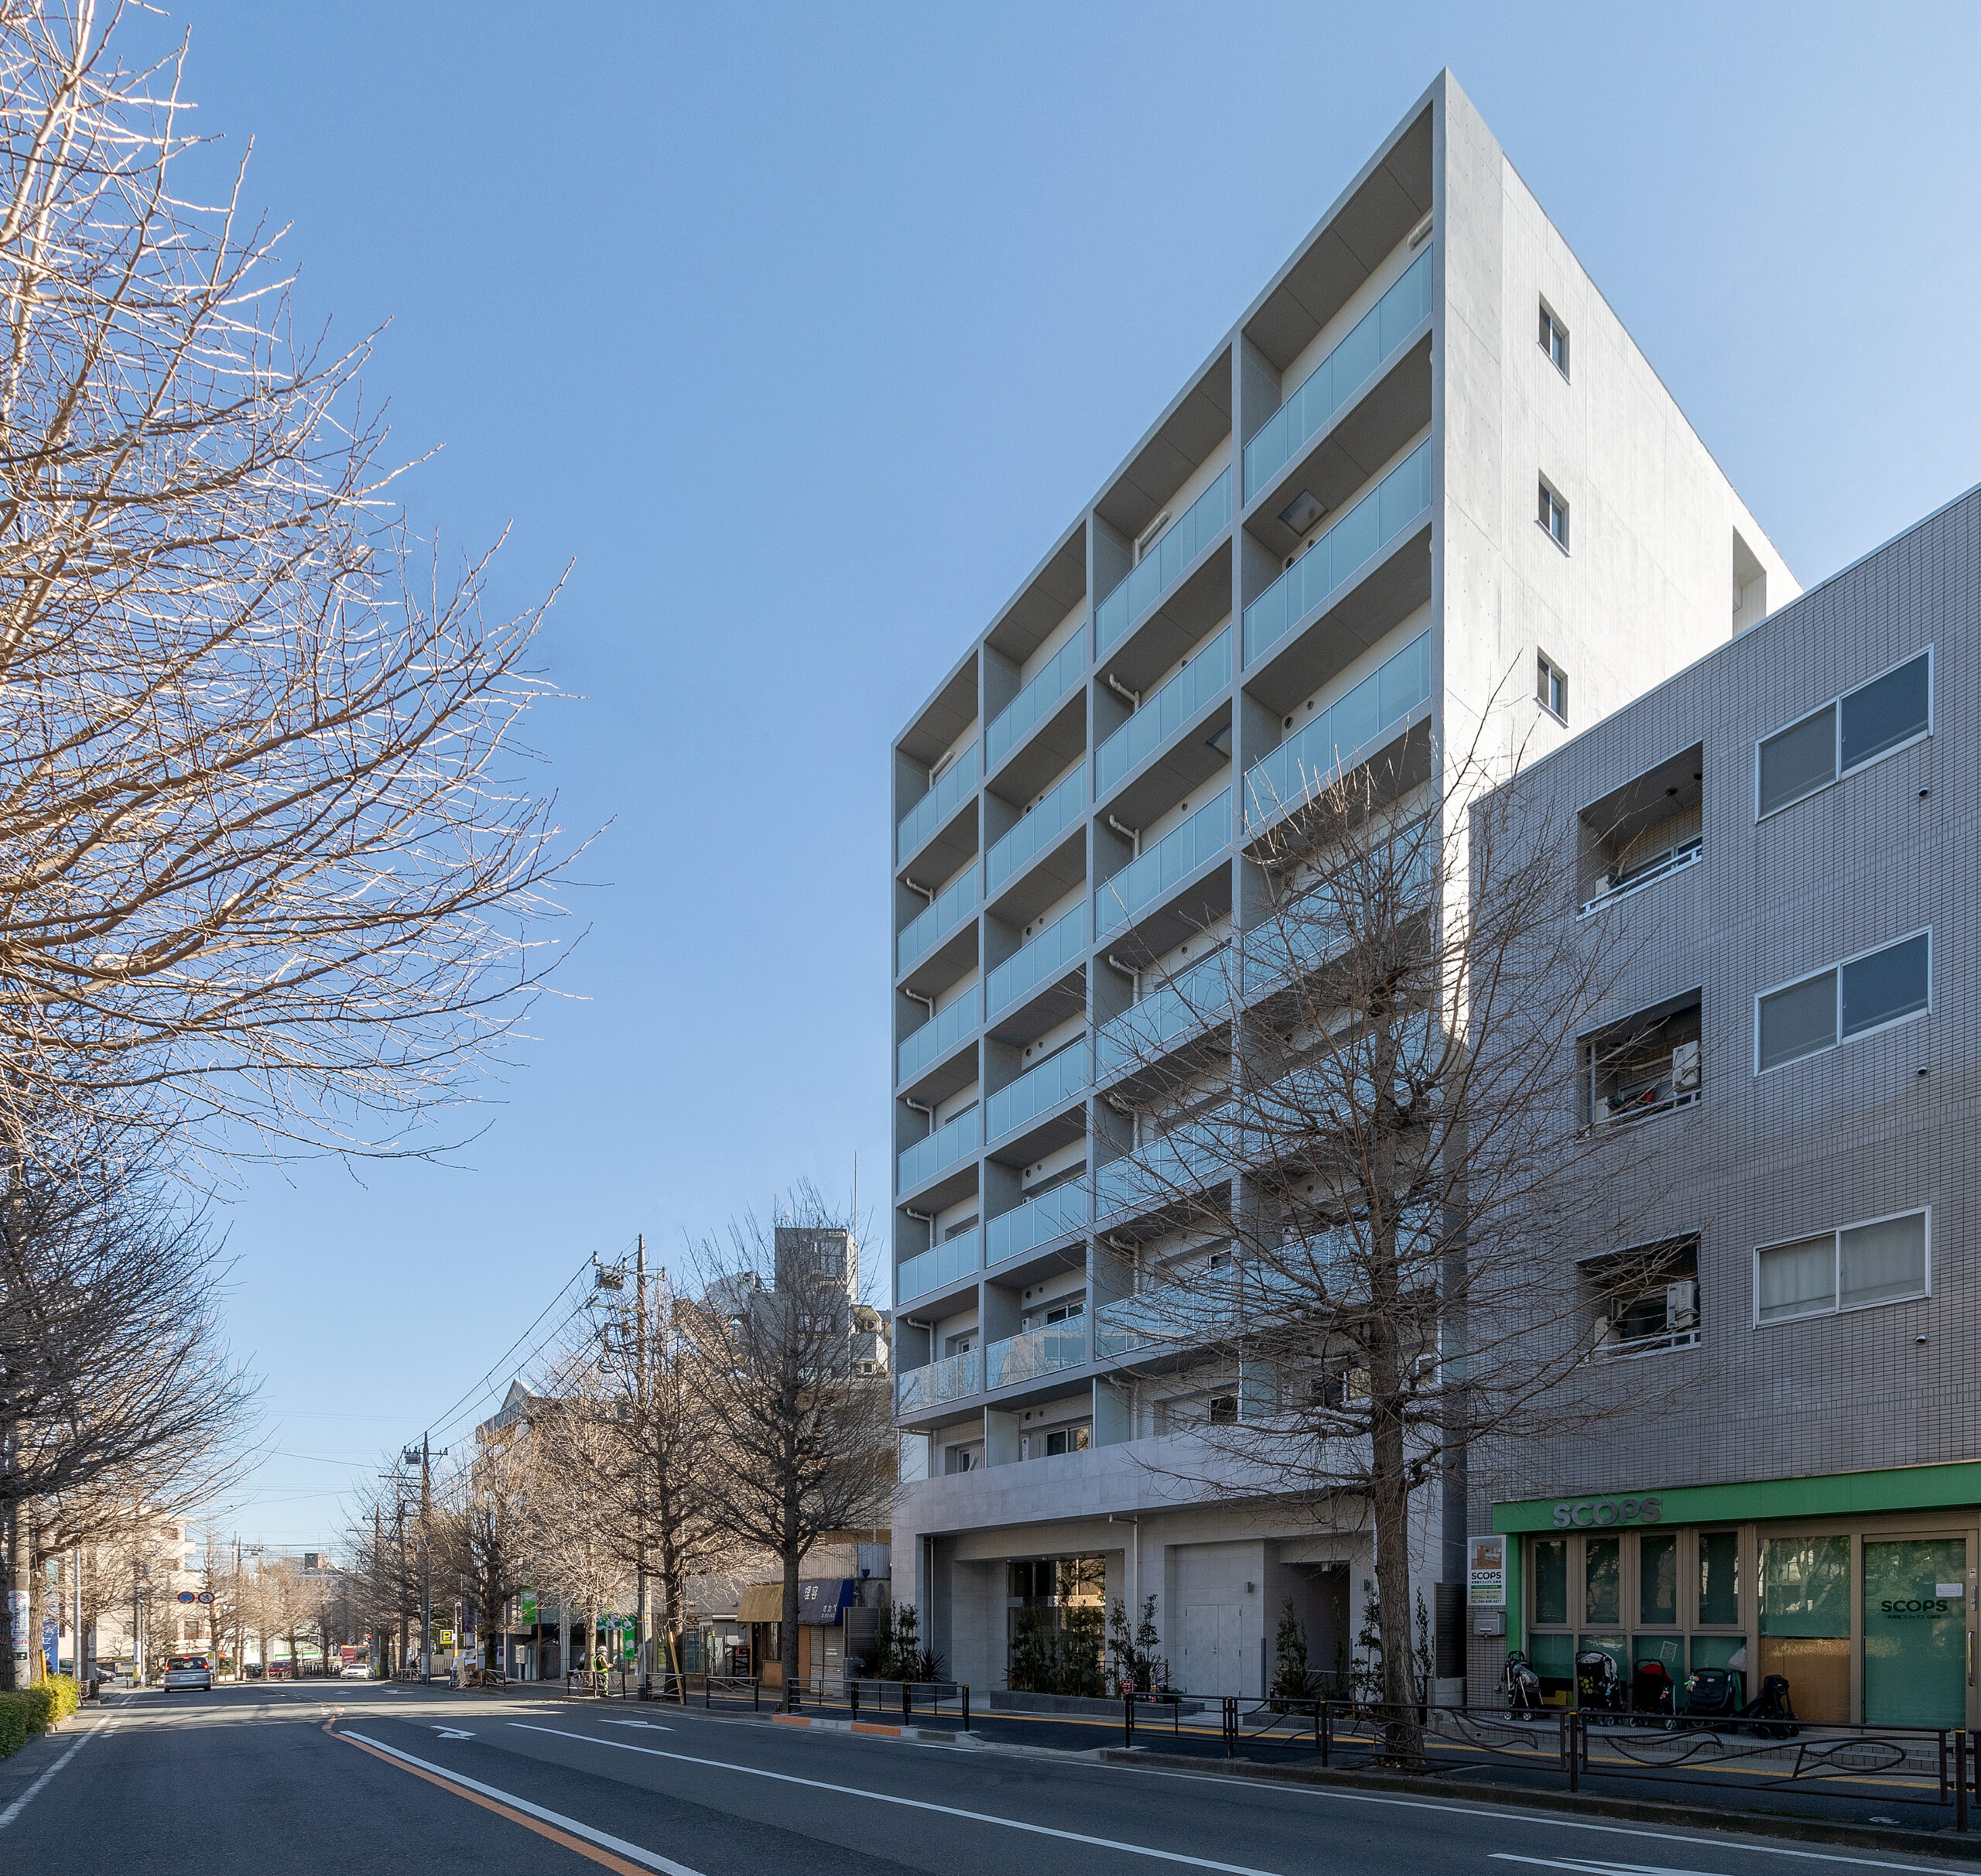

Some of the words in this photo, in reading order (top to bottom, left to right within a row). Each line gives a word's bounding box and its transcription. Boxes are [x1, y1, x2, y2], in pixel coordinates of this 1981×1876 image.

[1553, 1498, 1661, 1528] SCOPS
[803, 1585, 819, 1600] 理容
[1881, 1600, 1948, 1612] SCOPS
[443, 1631, 451, 1640] P
